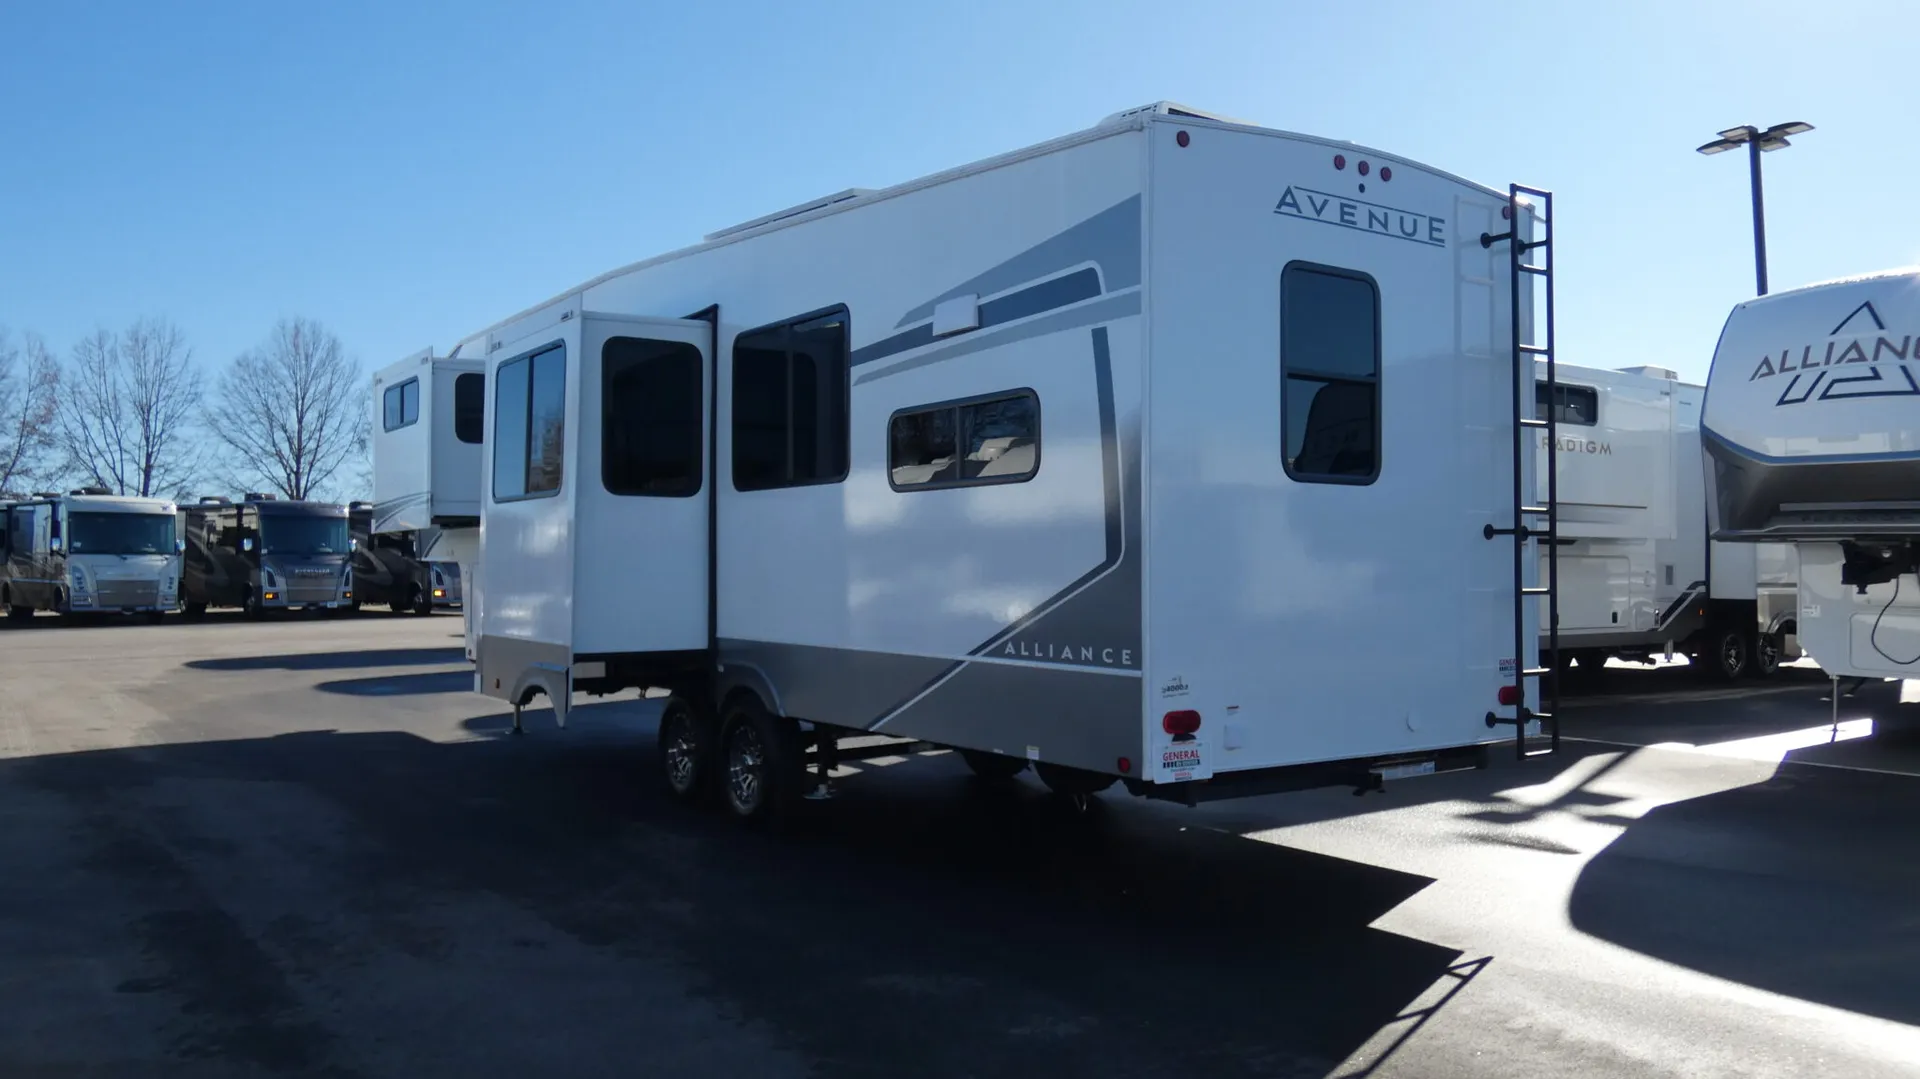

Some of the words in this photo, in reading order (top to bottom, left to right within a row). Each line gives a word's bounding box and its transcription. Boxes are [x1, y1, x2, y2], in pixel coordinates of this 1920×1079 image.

[1275, 185, 1445, 244] AVENUE
[1536, 435, 1612, 456] RADIGM
[1004, 641, 1132, 665] ALLIANCE
[1162, 749, 1200, 761] GENERAL
